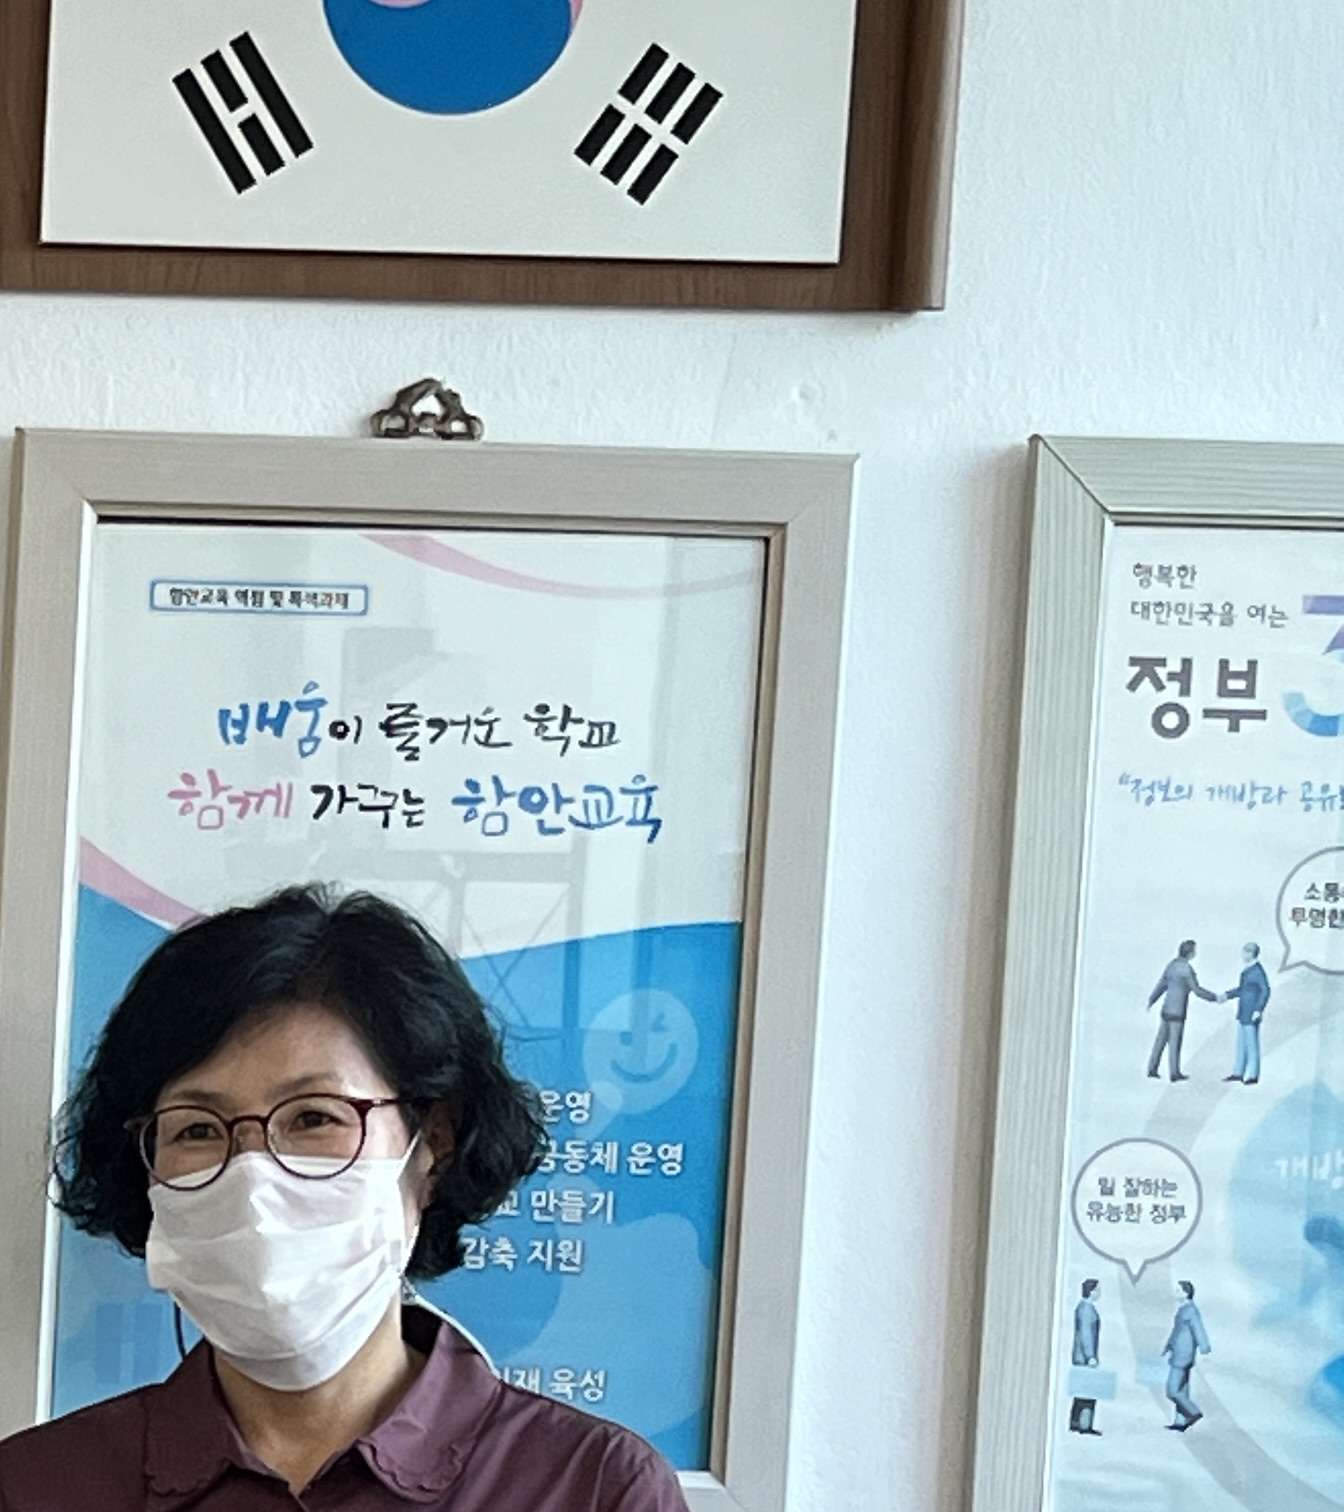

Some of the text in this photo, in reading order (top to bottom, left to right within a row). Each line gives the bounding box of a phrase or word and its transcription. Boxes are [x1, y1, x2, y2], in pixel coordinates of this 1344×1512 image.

[1132, 562, 1197, 590] 행복한
[1130, 601, 1289, 629] 대한민국을 여는
[1125, 655, 1268, 740] 정부
[218, 681, 621, 761] 배움이 즐거운 학교
[168, 769, 663, 844] 함께 가꾸는 함안교육
[627, 1141, 685, 1176] 운영
[530, 1189, 615, 1225] 만들기
[1149, 1203, 1187, 1224] 정부
[460, 1236, 583, 1273] 감축 지원
[548, 1368, 606, 1402] 육성
